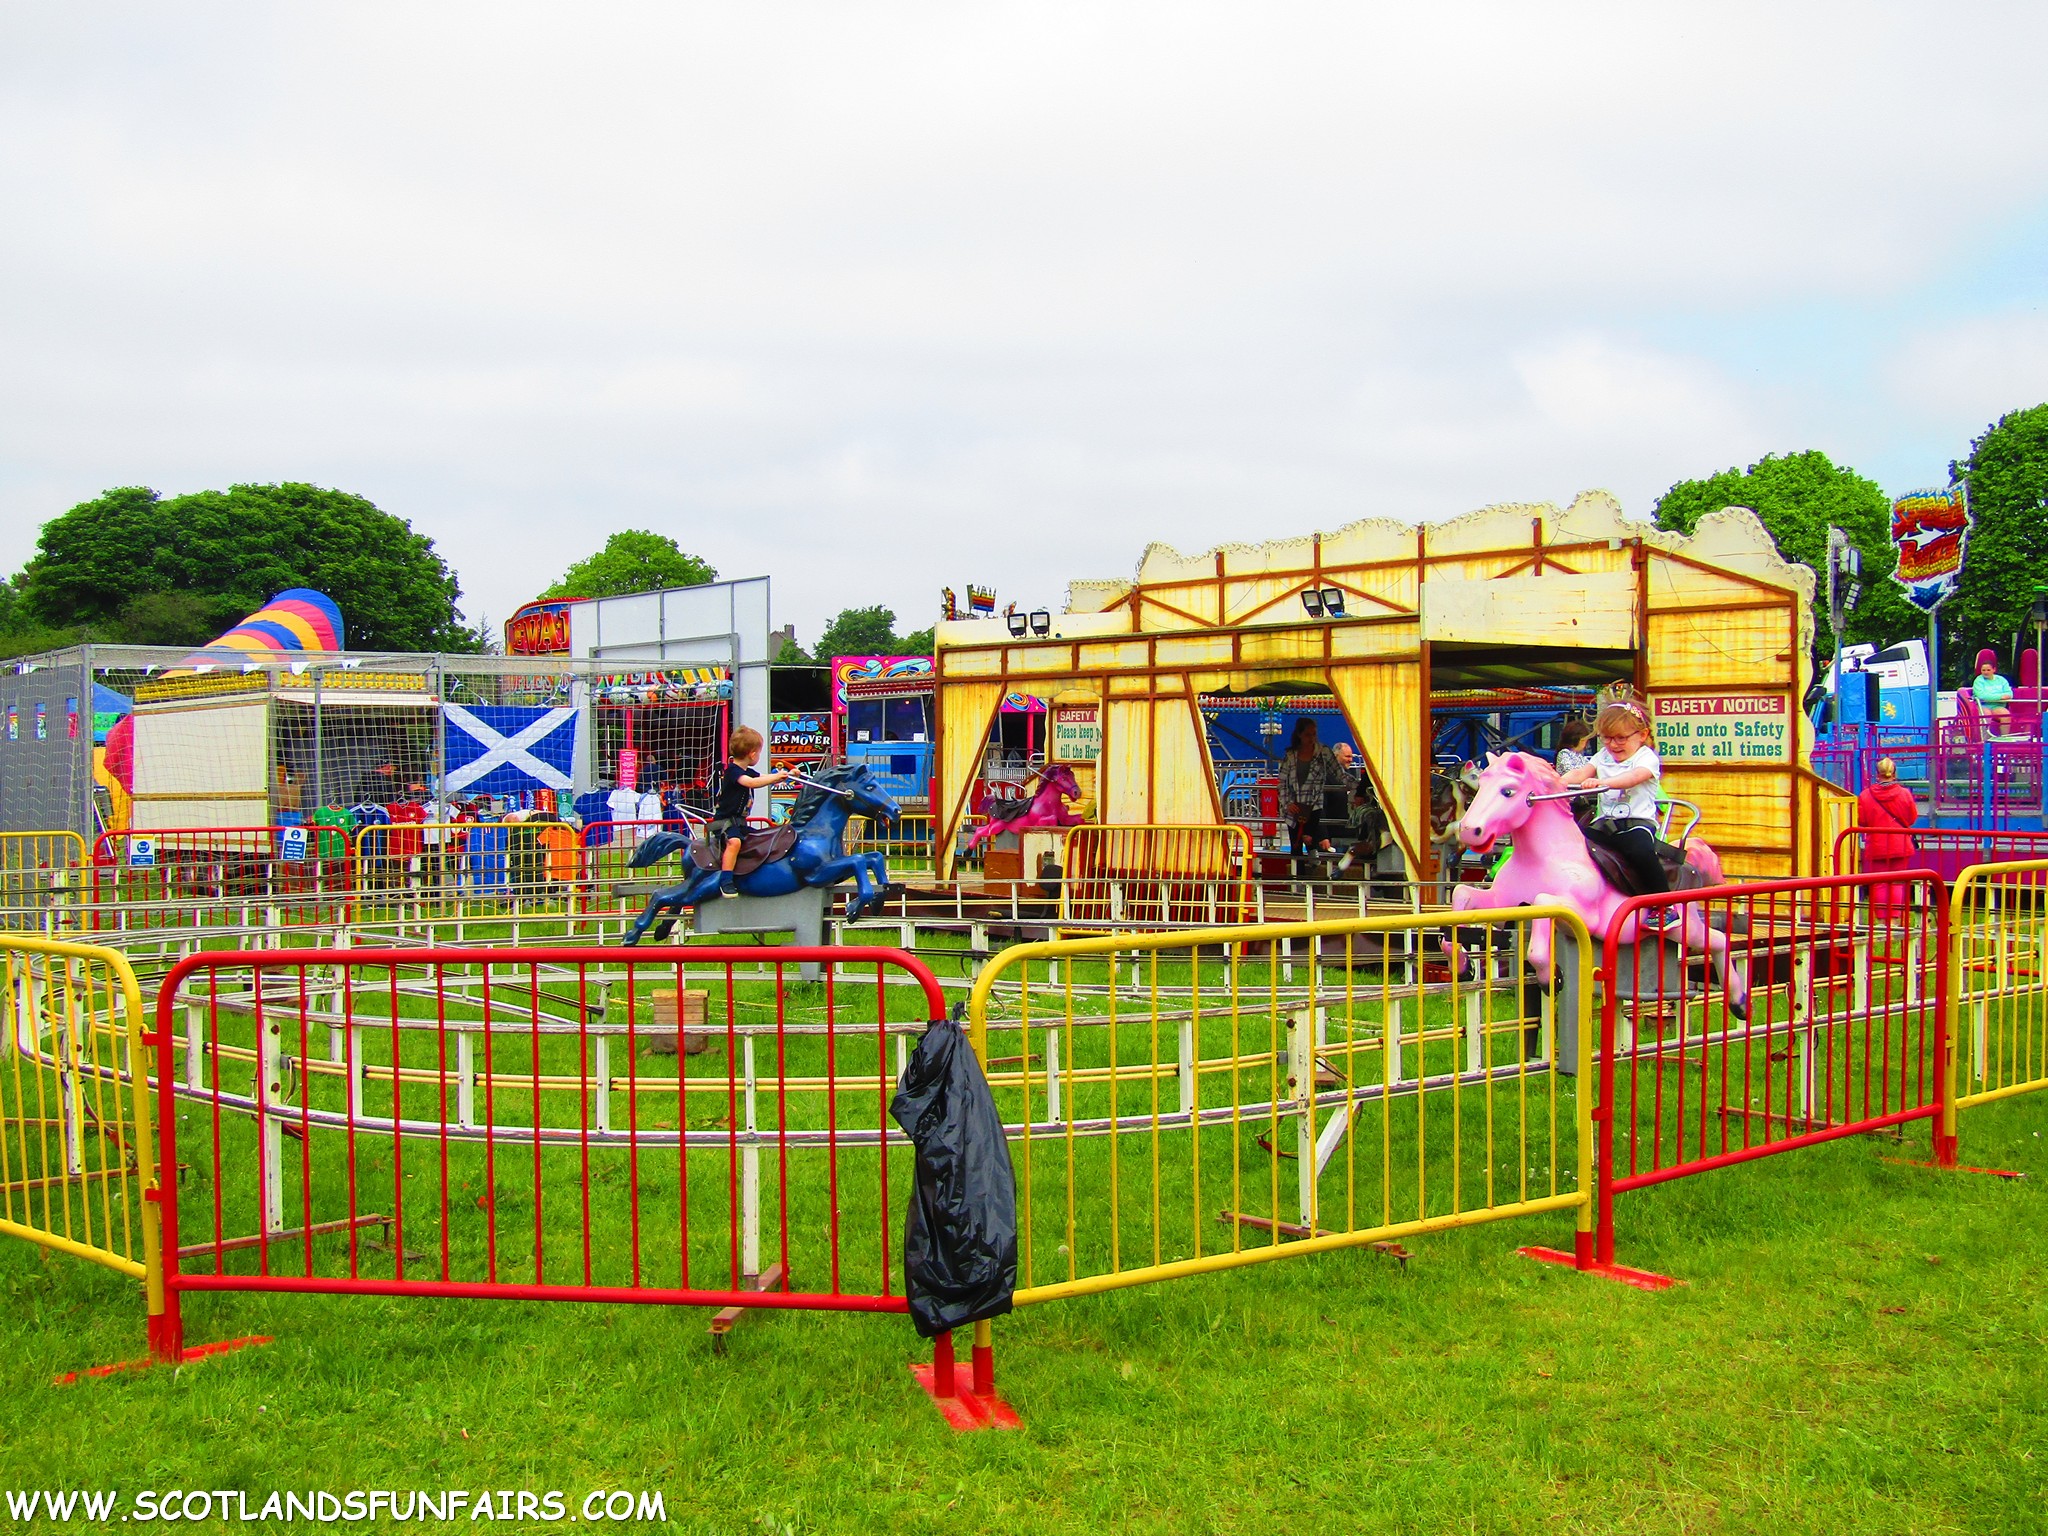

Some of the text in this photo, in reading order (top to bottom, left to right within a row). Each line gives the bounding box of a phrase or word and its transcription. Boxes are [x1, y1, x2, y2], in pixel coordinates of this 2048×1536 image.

[1661, 698, 1779, 714] SAFETY NOTICE
[1060, 711, 1091, 721] SAFETY
[1057, 724, 1076, 739] Please
[1079, 724, 1093, 742] keep
[1656, 721, 1784, 740] Hold onto Safety
[790, 734, 830, 746] MOVER
[1060, 744, 1070, 758] till
[1073, 744, 1082, 758] the
[1658, 742, 1782, 756] Bar at all times
